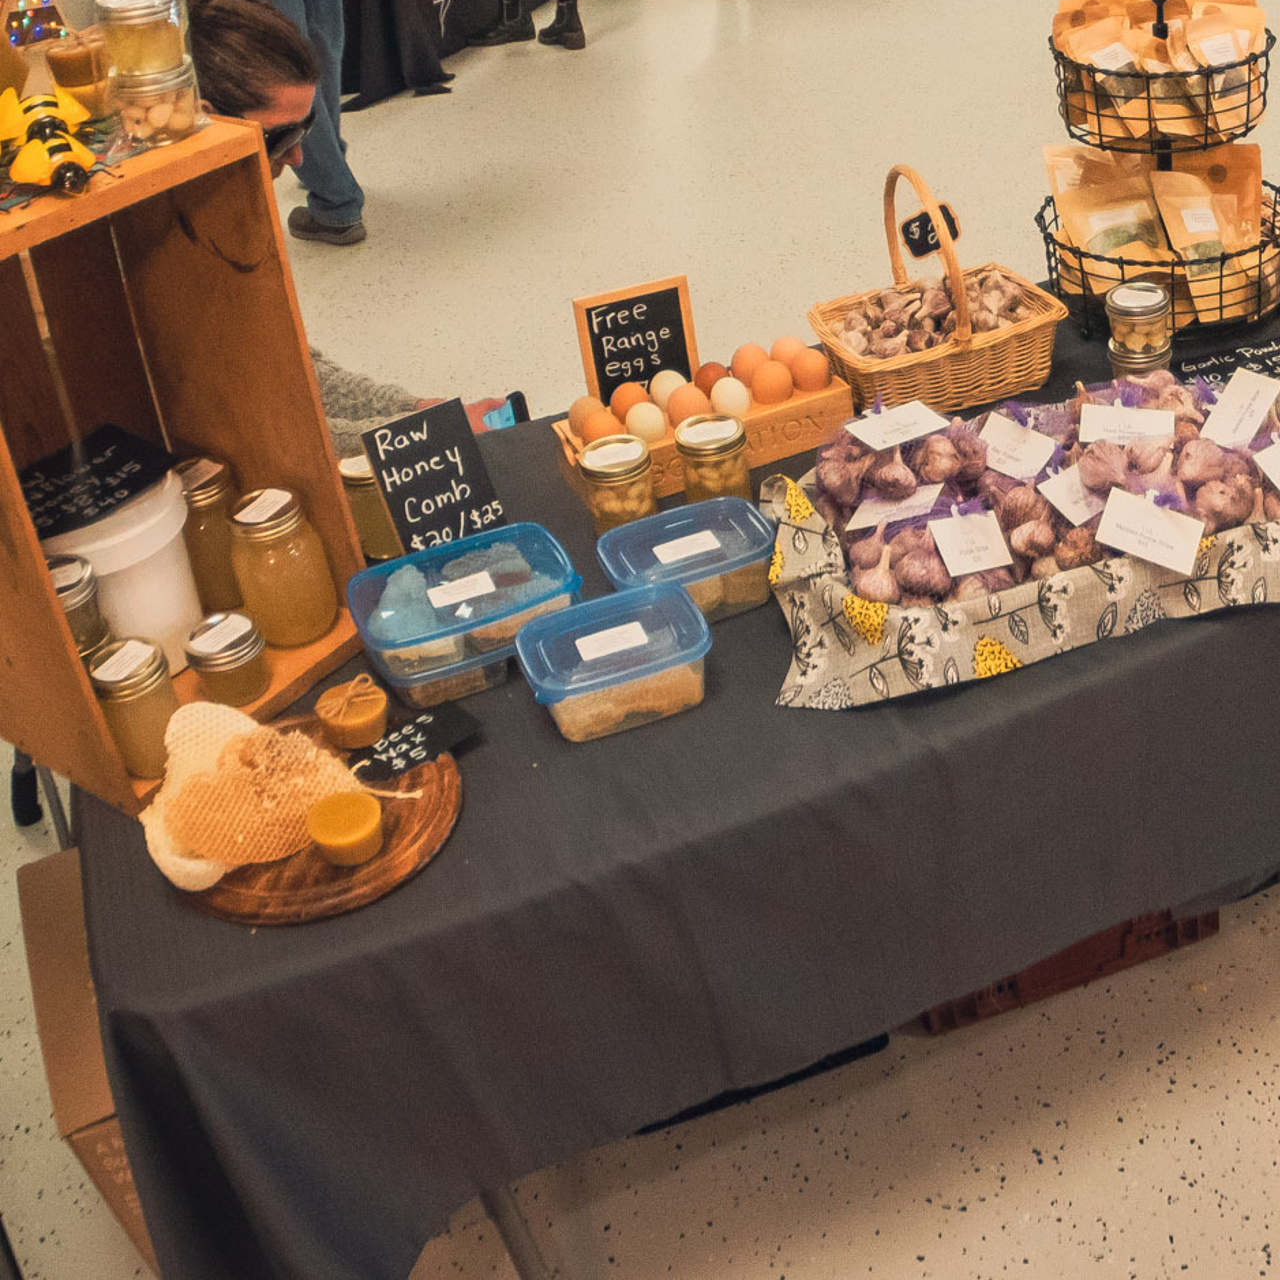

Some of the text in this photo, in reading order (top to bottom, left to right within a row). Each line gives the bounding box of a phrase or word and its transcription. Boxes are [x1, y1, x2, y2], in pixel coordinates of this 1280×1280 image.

[591, 303, 647, 334] Free
[601, 327, 672, 359] Range
[605, 354, 661, 377] eggs
[1181, 355, 1236, 372] Garlic
[374, 419, 428, 461] Raw
[381, 446, 464, 493] Honey
[404, 479, 471, 524] Comb
[391, 746, 427, 770] $5
